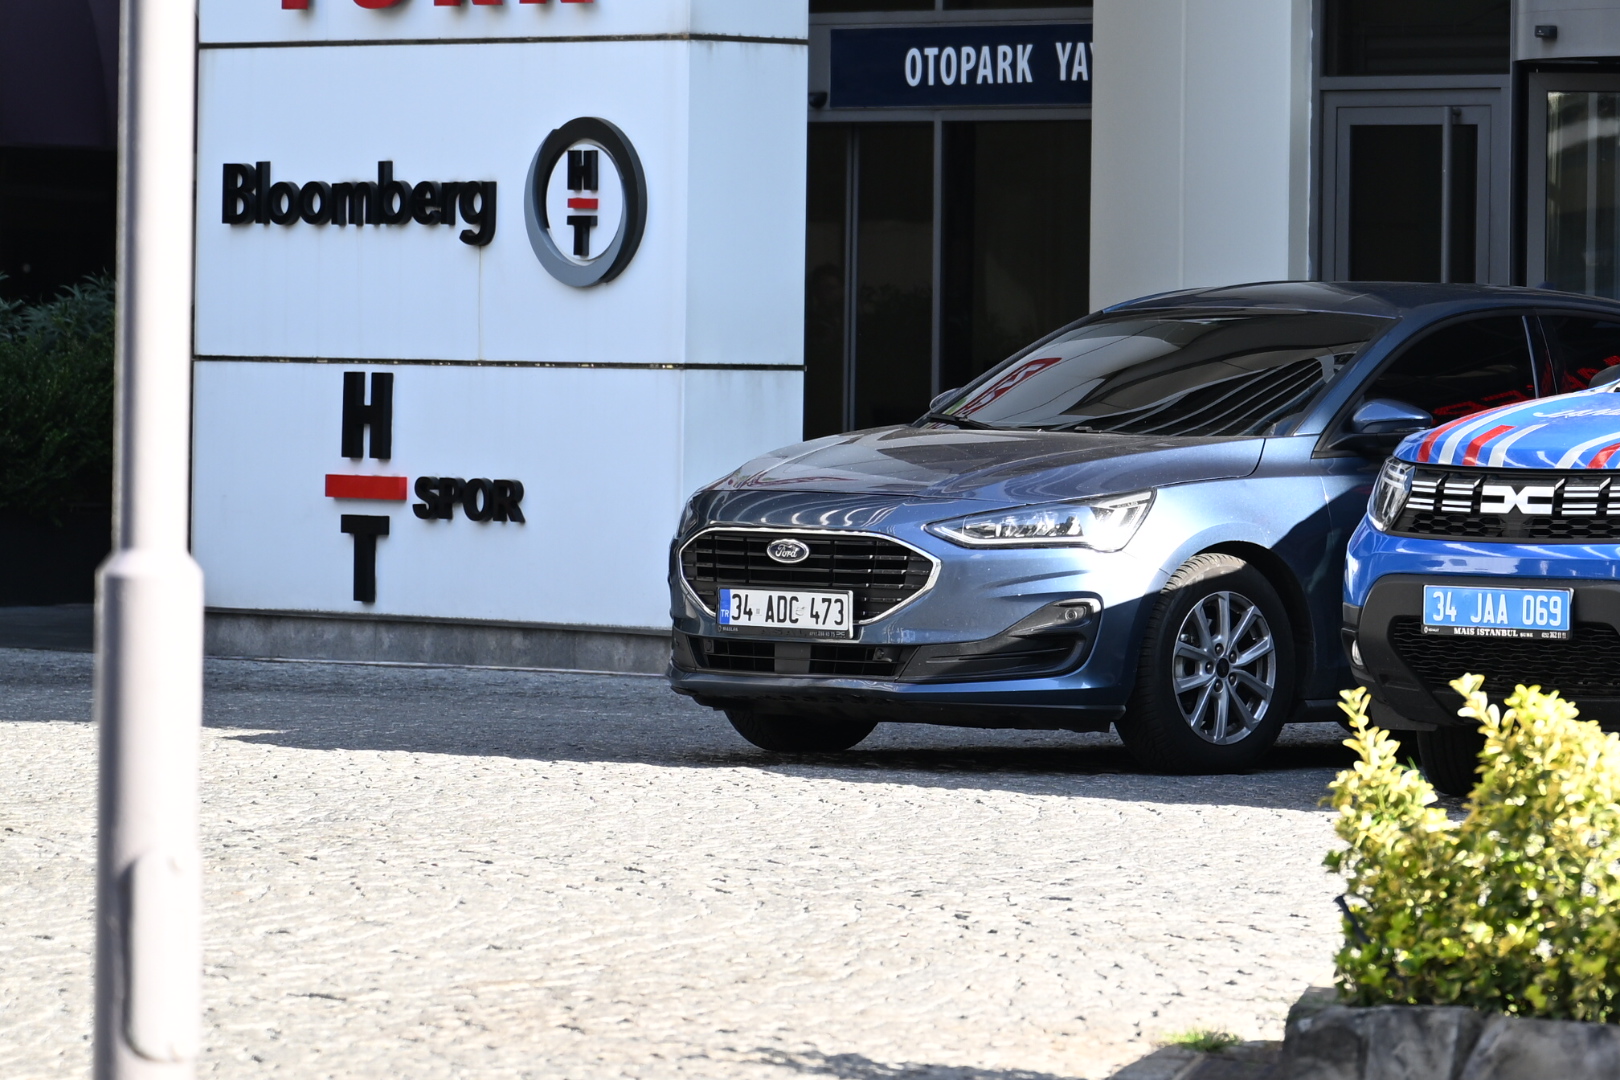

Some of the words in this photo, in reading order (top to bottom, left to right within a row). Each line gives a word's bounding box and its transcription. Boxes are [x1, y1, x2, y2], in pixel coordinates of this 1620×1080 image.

[905, 44, 1033, 86] OTOPARK
[1055, 42, 1093, 81] YA
[222, 160, 497, 246] Bloomberg
[412, 476, 525, 522] SPOR
[775, 544, 799, 558] Ford
[721, 609, 730, 617] TR
[731, 594, 753, 621] 34
[765, 595, 799, 623] ADC
[810, 597, 844, 626] 473
[1433, 592, 1457, 622] 34
[1470, 593, 1508, 624] JAA
[1522, 595, 1562, 626] 069
